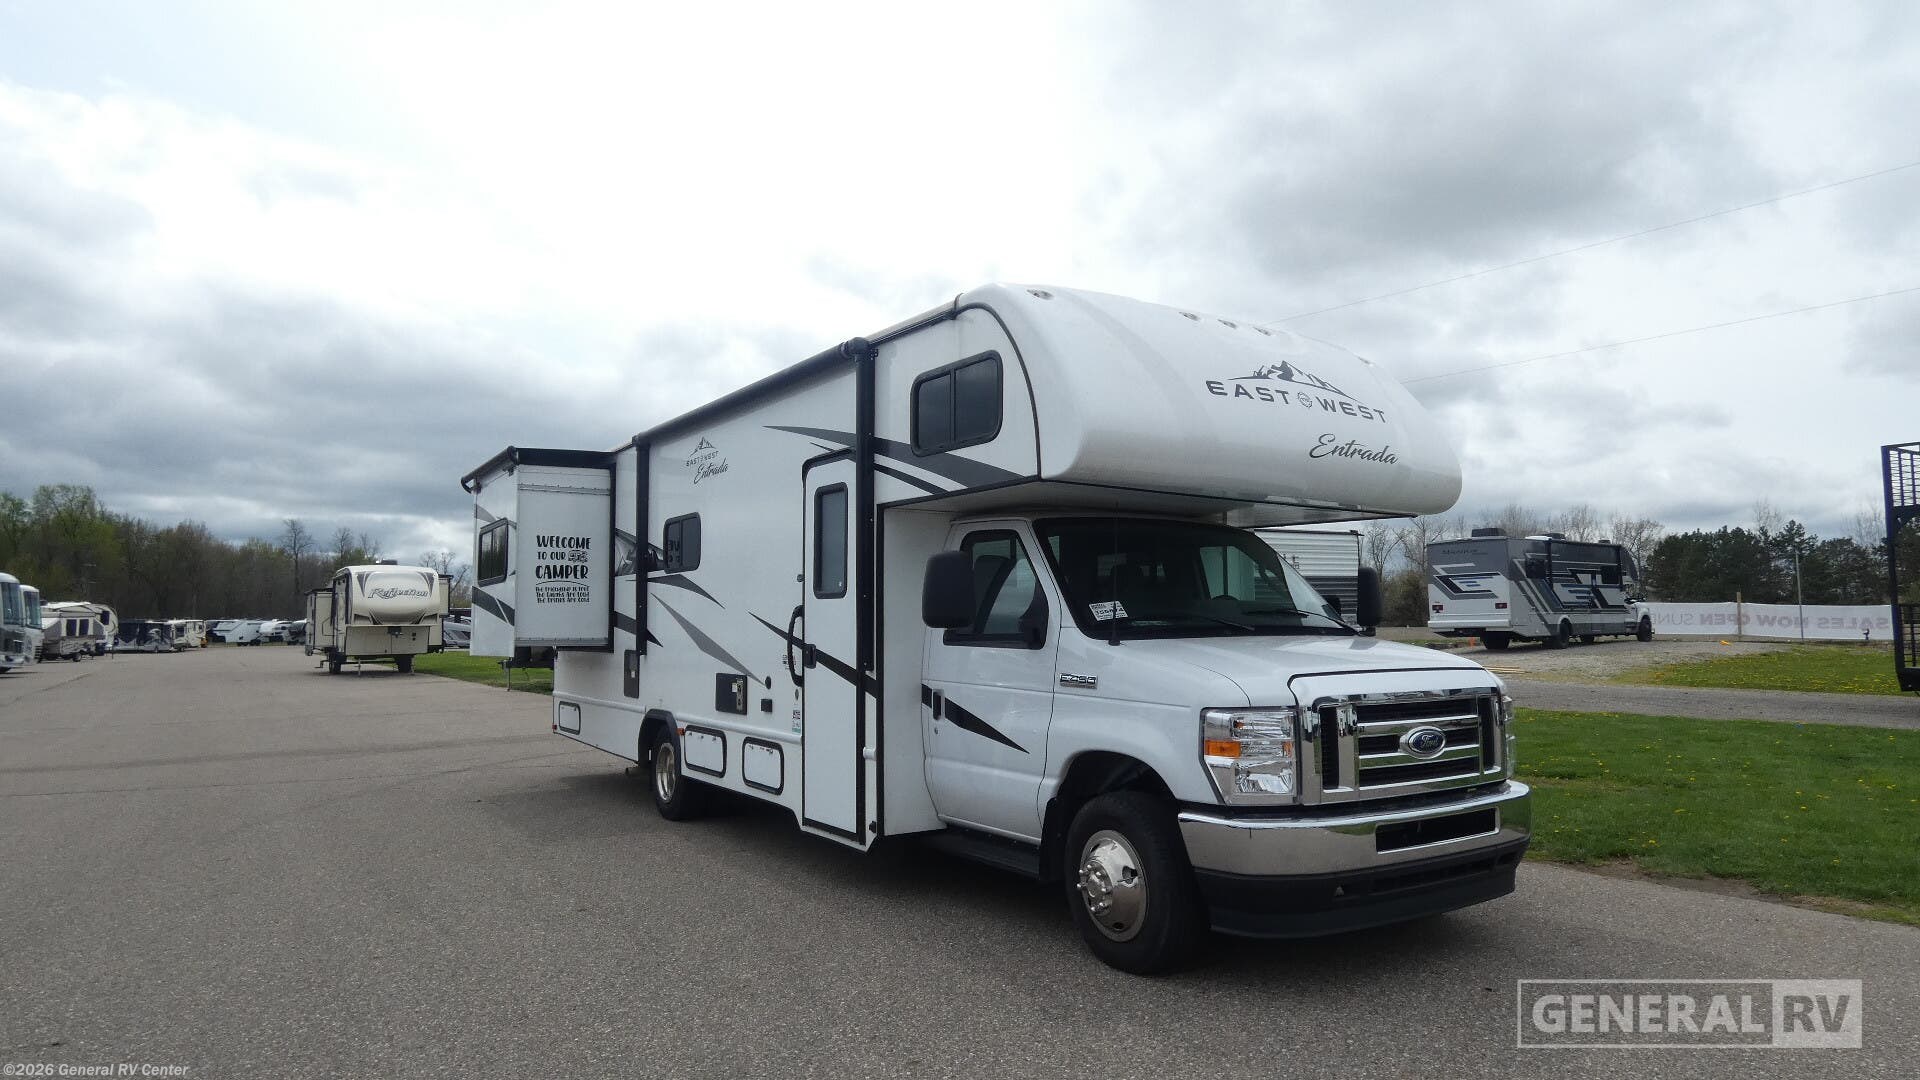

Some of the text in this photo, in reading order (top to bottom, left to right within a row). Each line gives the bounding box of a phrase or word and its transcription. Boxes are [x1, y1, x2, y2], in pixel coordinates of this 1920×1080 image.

[1206, 380, 1386, 423] EAST WEST
[1309, 433, 1398, 465] Entrada
[694, 457, 728, 484] Entrada
[536, 535, 591, 549] WELCOME
[537, 551, 566, 560] TO OUR
[535, 564, 589, 579] CAMPER
[368, 587, 429, 599] Reflection
